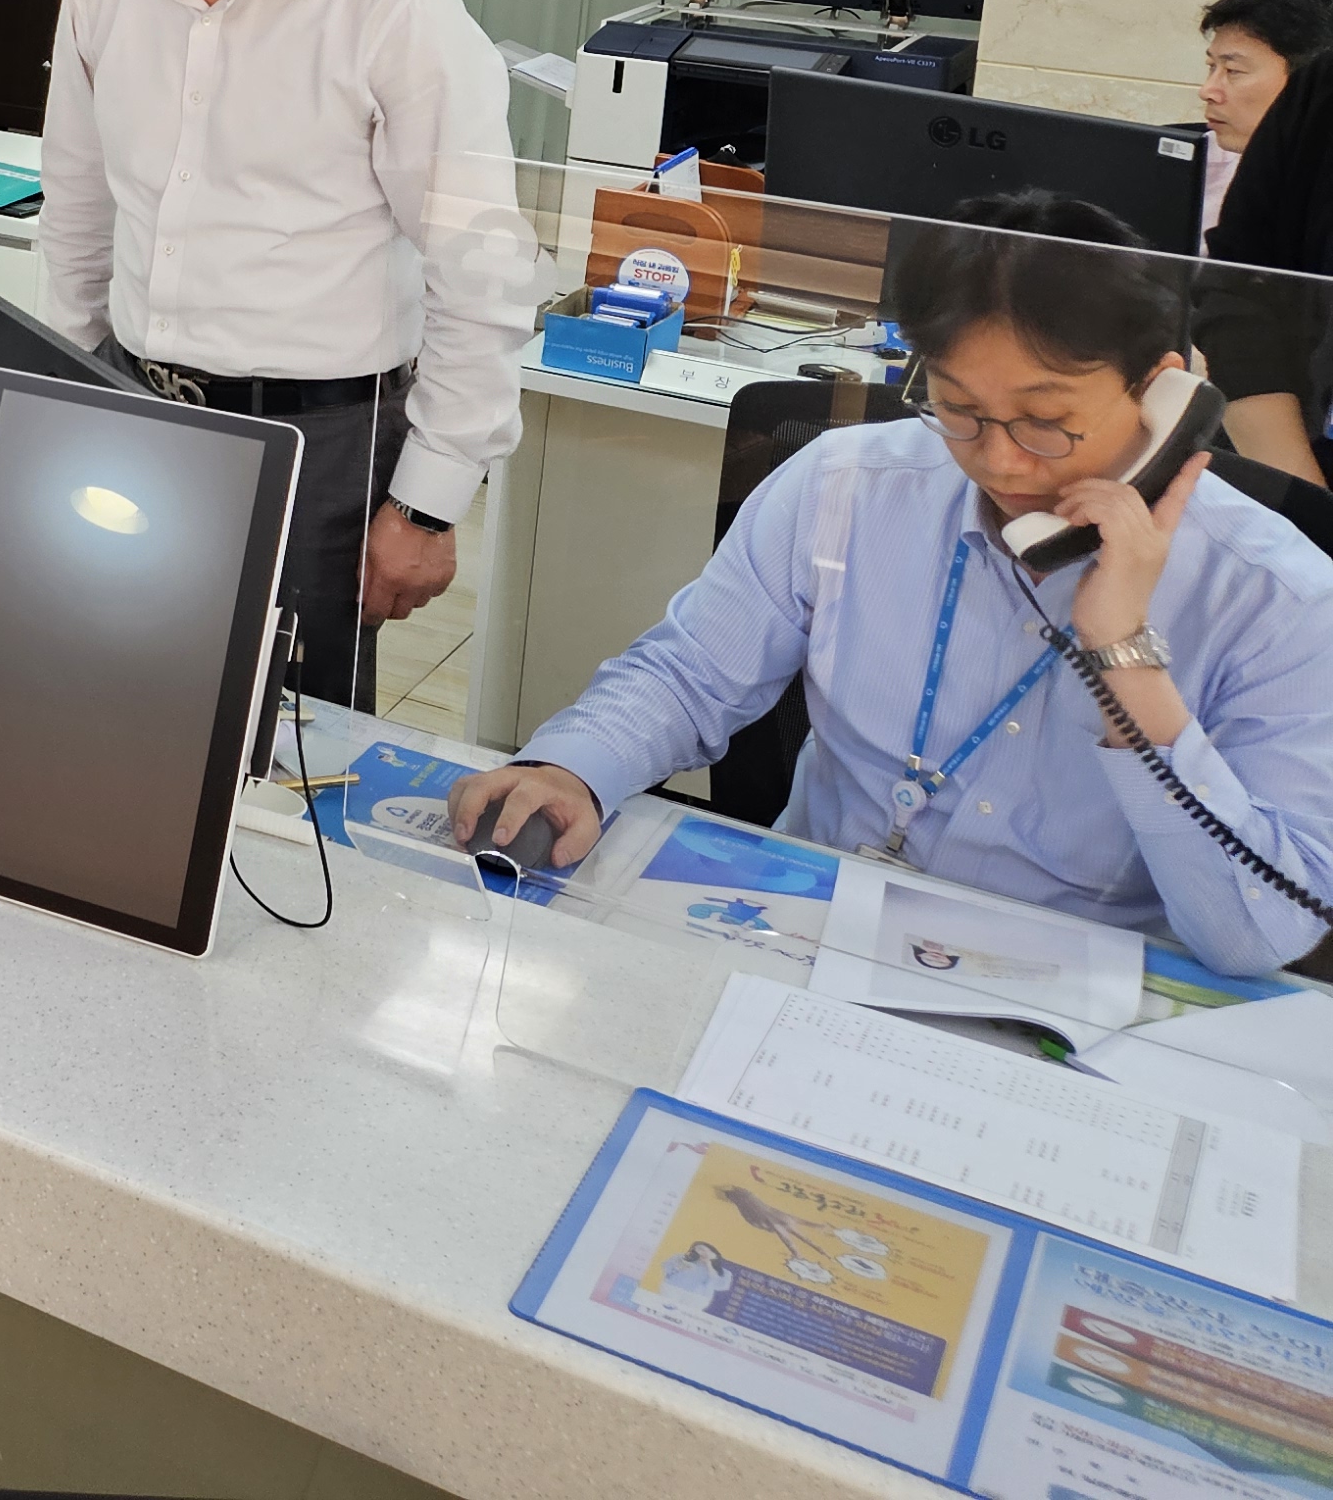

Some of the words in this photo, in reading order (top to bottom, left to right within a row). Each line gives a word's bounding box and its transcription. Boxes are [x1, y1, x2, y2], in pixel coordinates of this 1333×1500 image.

[968, 127, 1007, 151] LG
[634, 268, 676, 285] STOP!
[587, 355, 633, 373] Business
